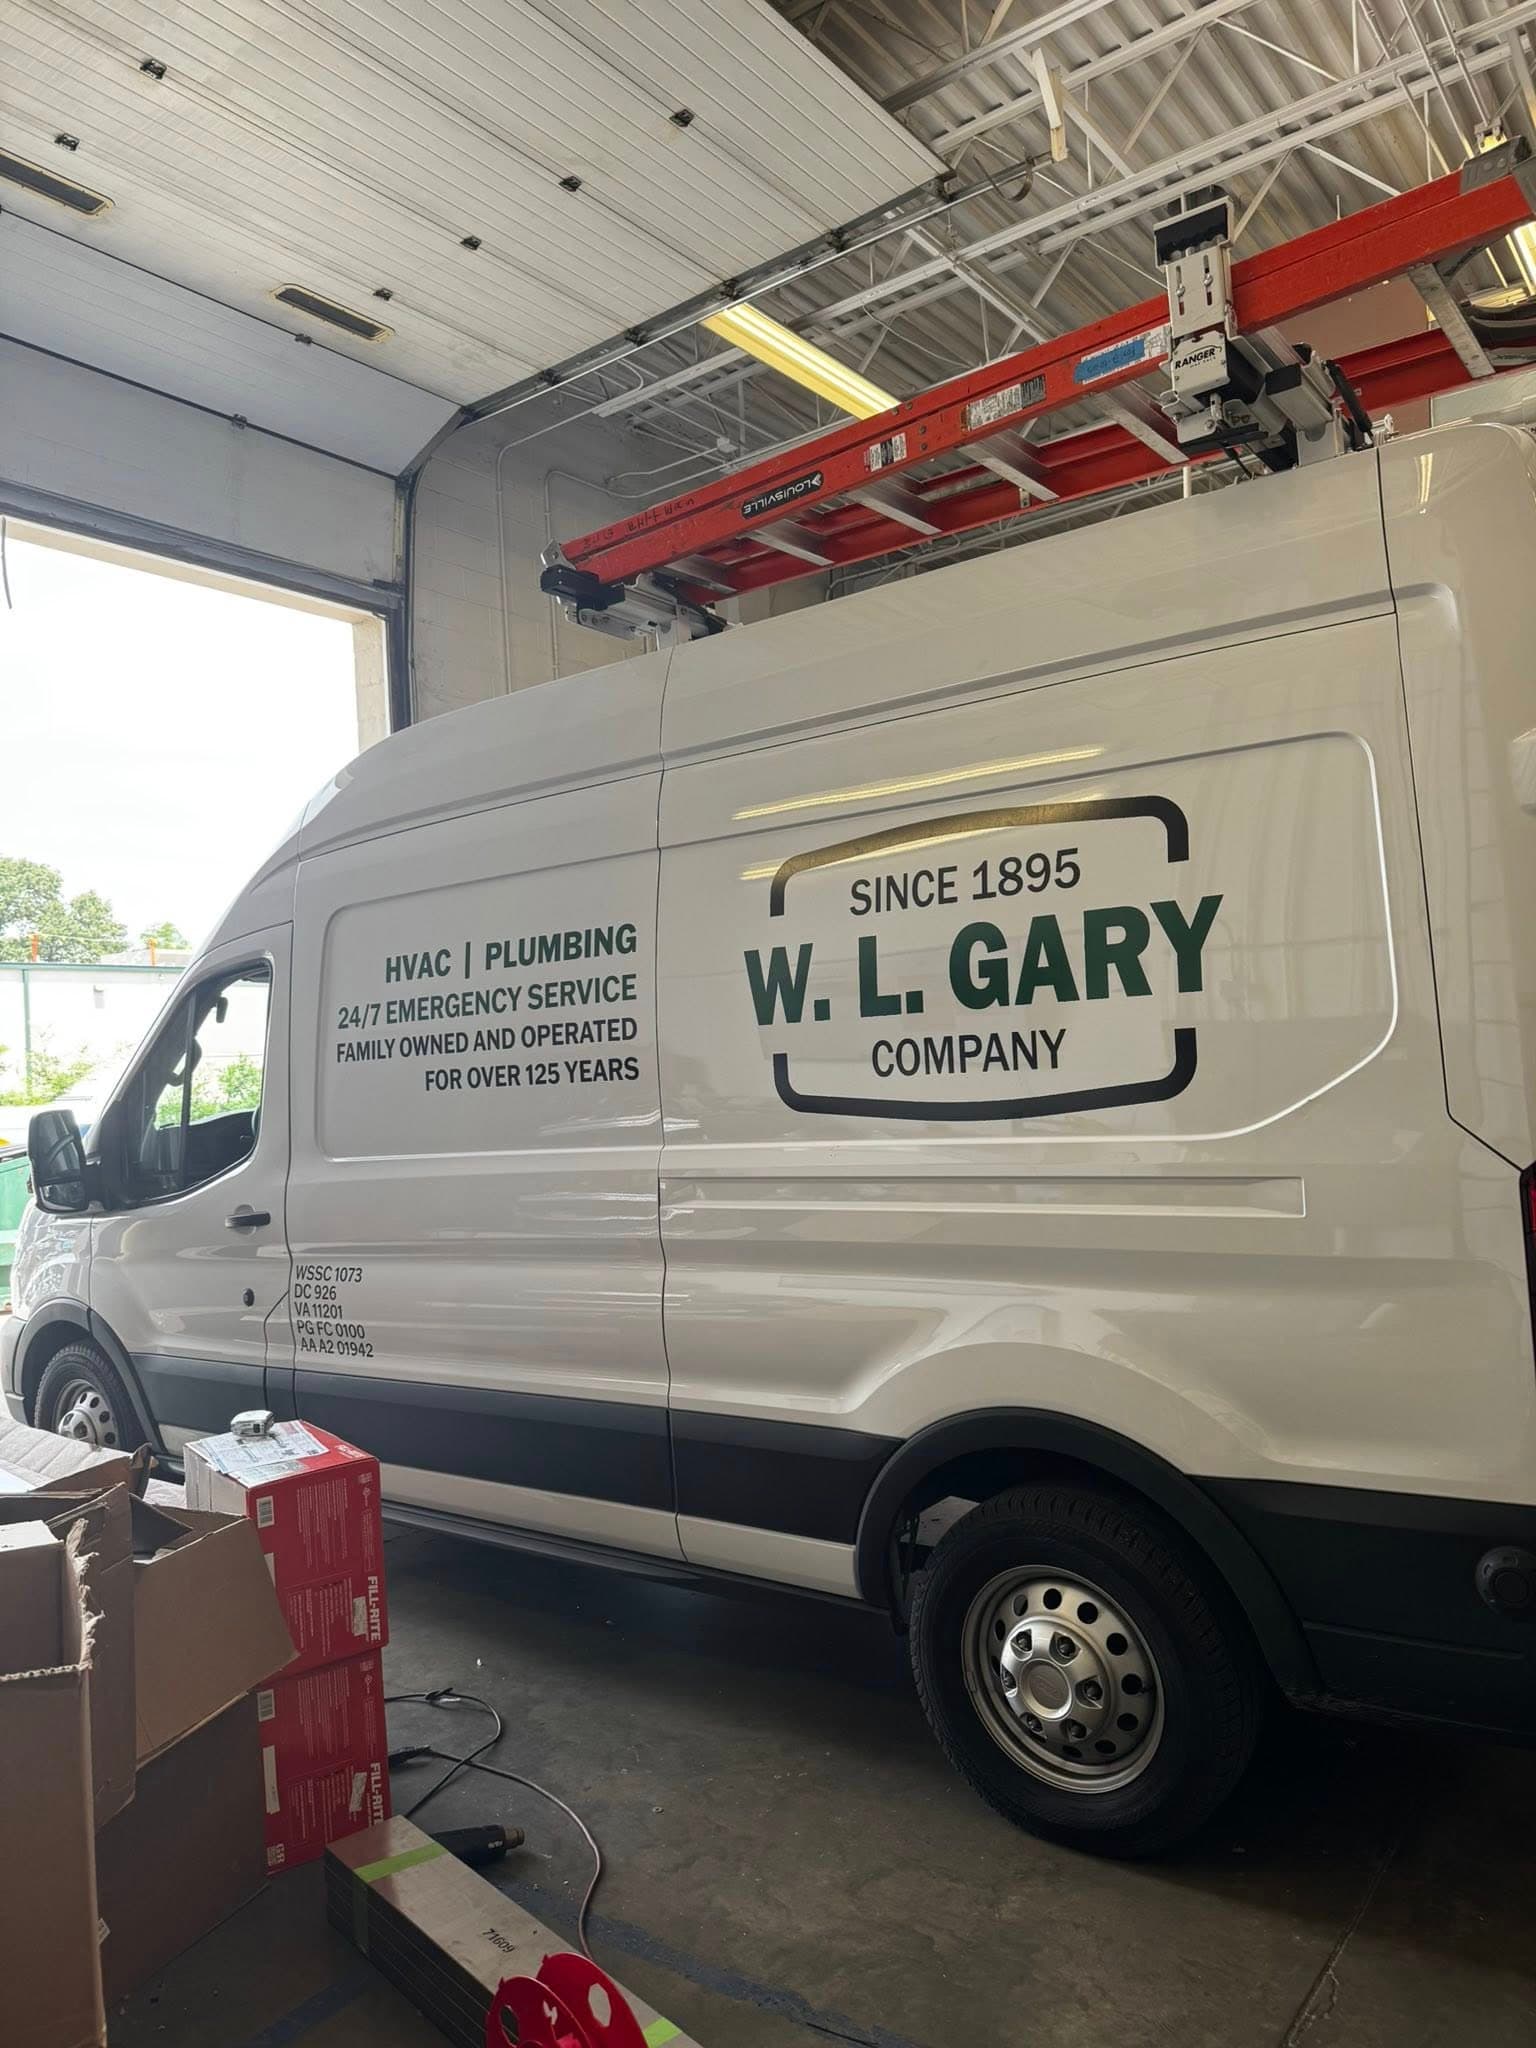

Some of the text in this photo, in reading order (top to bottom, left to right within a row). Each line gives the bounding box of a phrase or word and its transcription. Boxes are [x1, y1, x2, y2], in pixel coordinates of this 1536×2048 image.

[1175, 348, 1215, 369] RANGER
[743, 479, 811, 515] LOUISVILLE
[849, 847, 1081, 916] SINCE 1895
[385, 949, 451, 983] HVAC
[485, 923, 638, 971] PLUMBING
[743, 894, 1225, 1026] W. L. GARY
[337, 973, 638, 1030] 24/7 EMERGENCY SERVICE
[336, 1017, 638, 1063] FAMILY OWNED AND OPERATED
[871, 1028, 1067, 1078] COMPANY
[425, 1056, 639, 1091] FOR OVER 125 YEARS
[296, 1264, 363, 1283] WSSC 1073
[294, 1283, 337, 1301] DC 926
[294, 1302, 343, 1320] VA 11201
[296, 1319, 366, 1339] PG FC 0100
[337, 1340, 375, 1358] 01942
[368, 1575, 382, 1641] FILL-RITE
[482, 1928, 516, 1953] 71609
